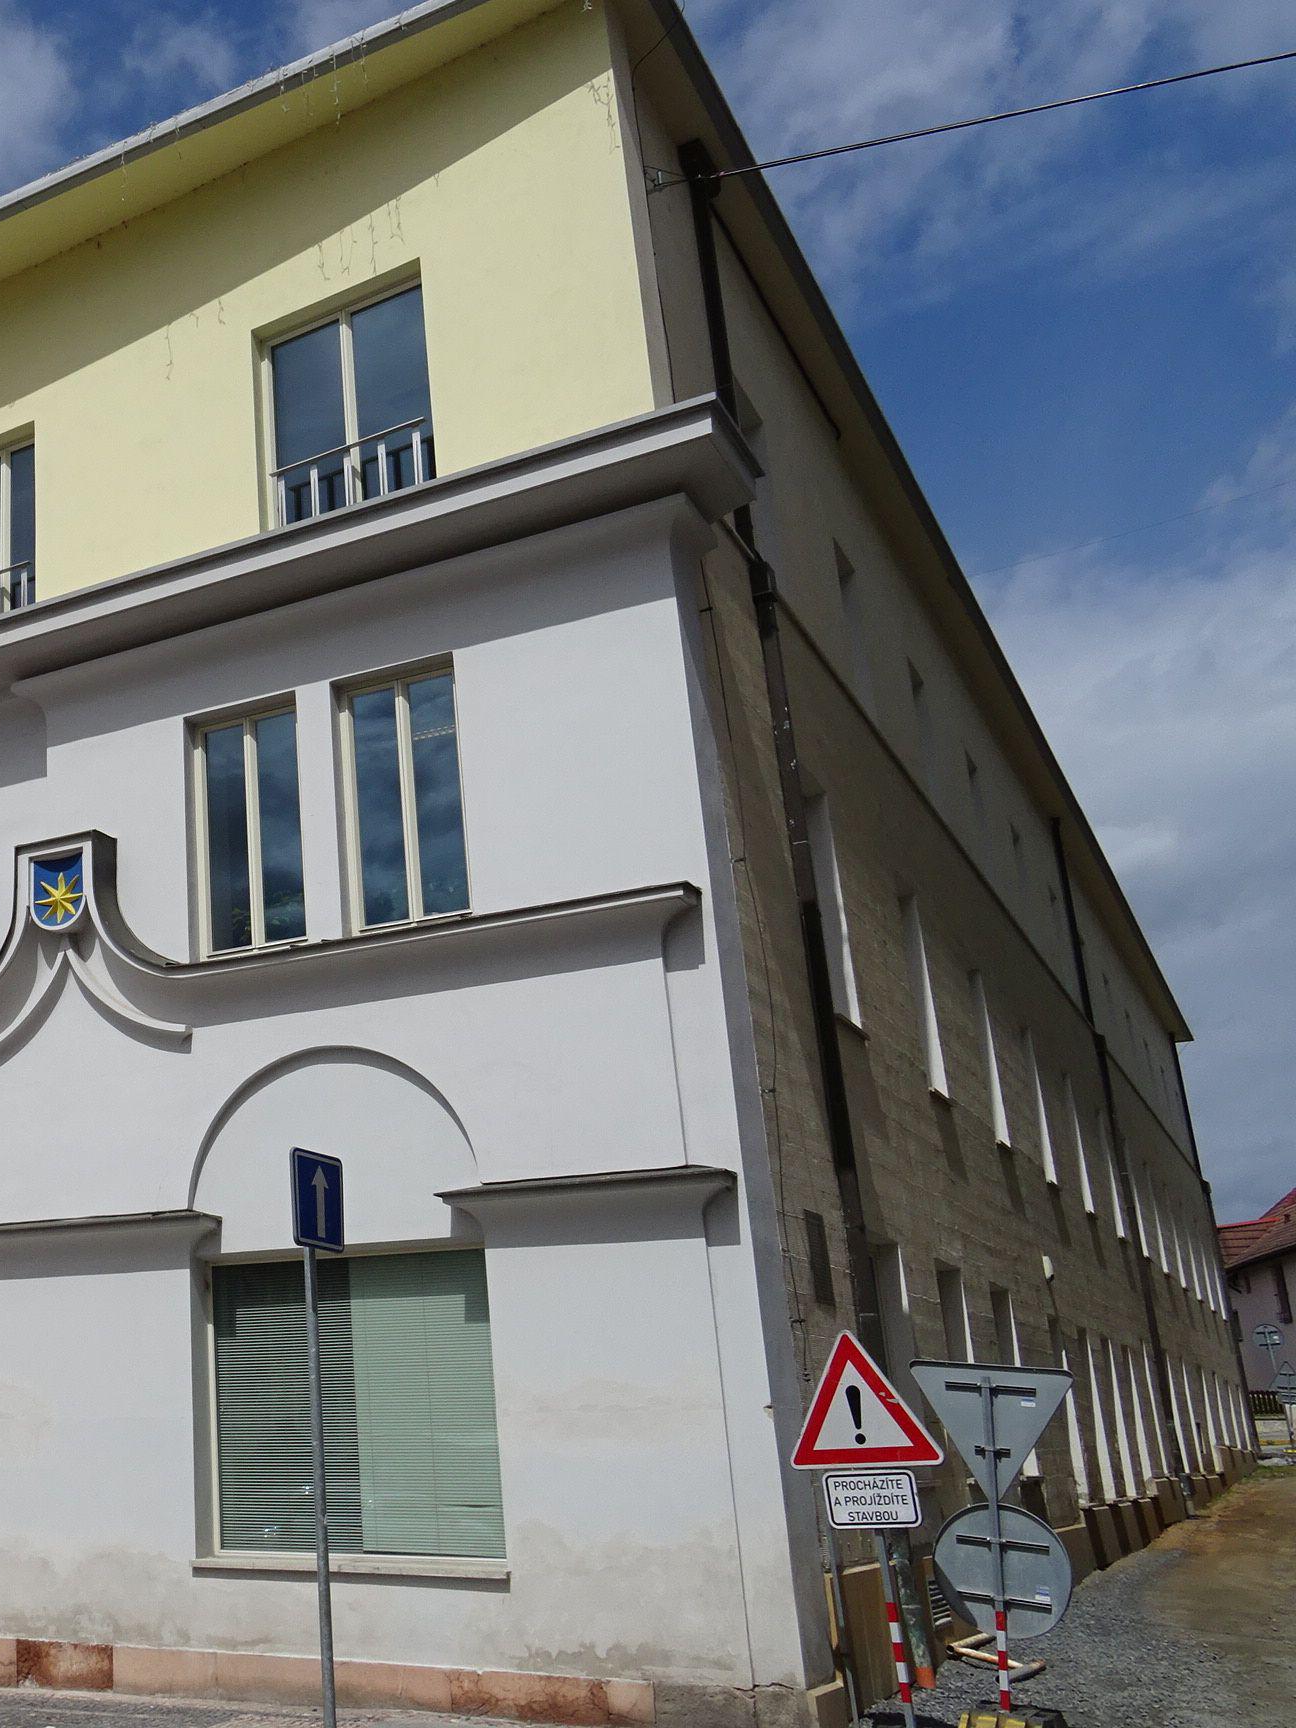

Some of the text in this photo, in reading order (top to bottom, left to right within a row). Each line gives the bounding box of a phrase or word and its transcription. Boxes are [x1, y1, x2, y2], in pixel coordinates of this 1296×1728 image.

[833, 1477, 904, 1491] PROCHÁZÍTE
[833, 1492, 909, 1507] A PROJÍŽDÍTE
[847, 1510, 899, 1522] STAVBOU
